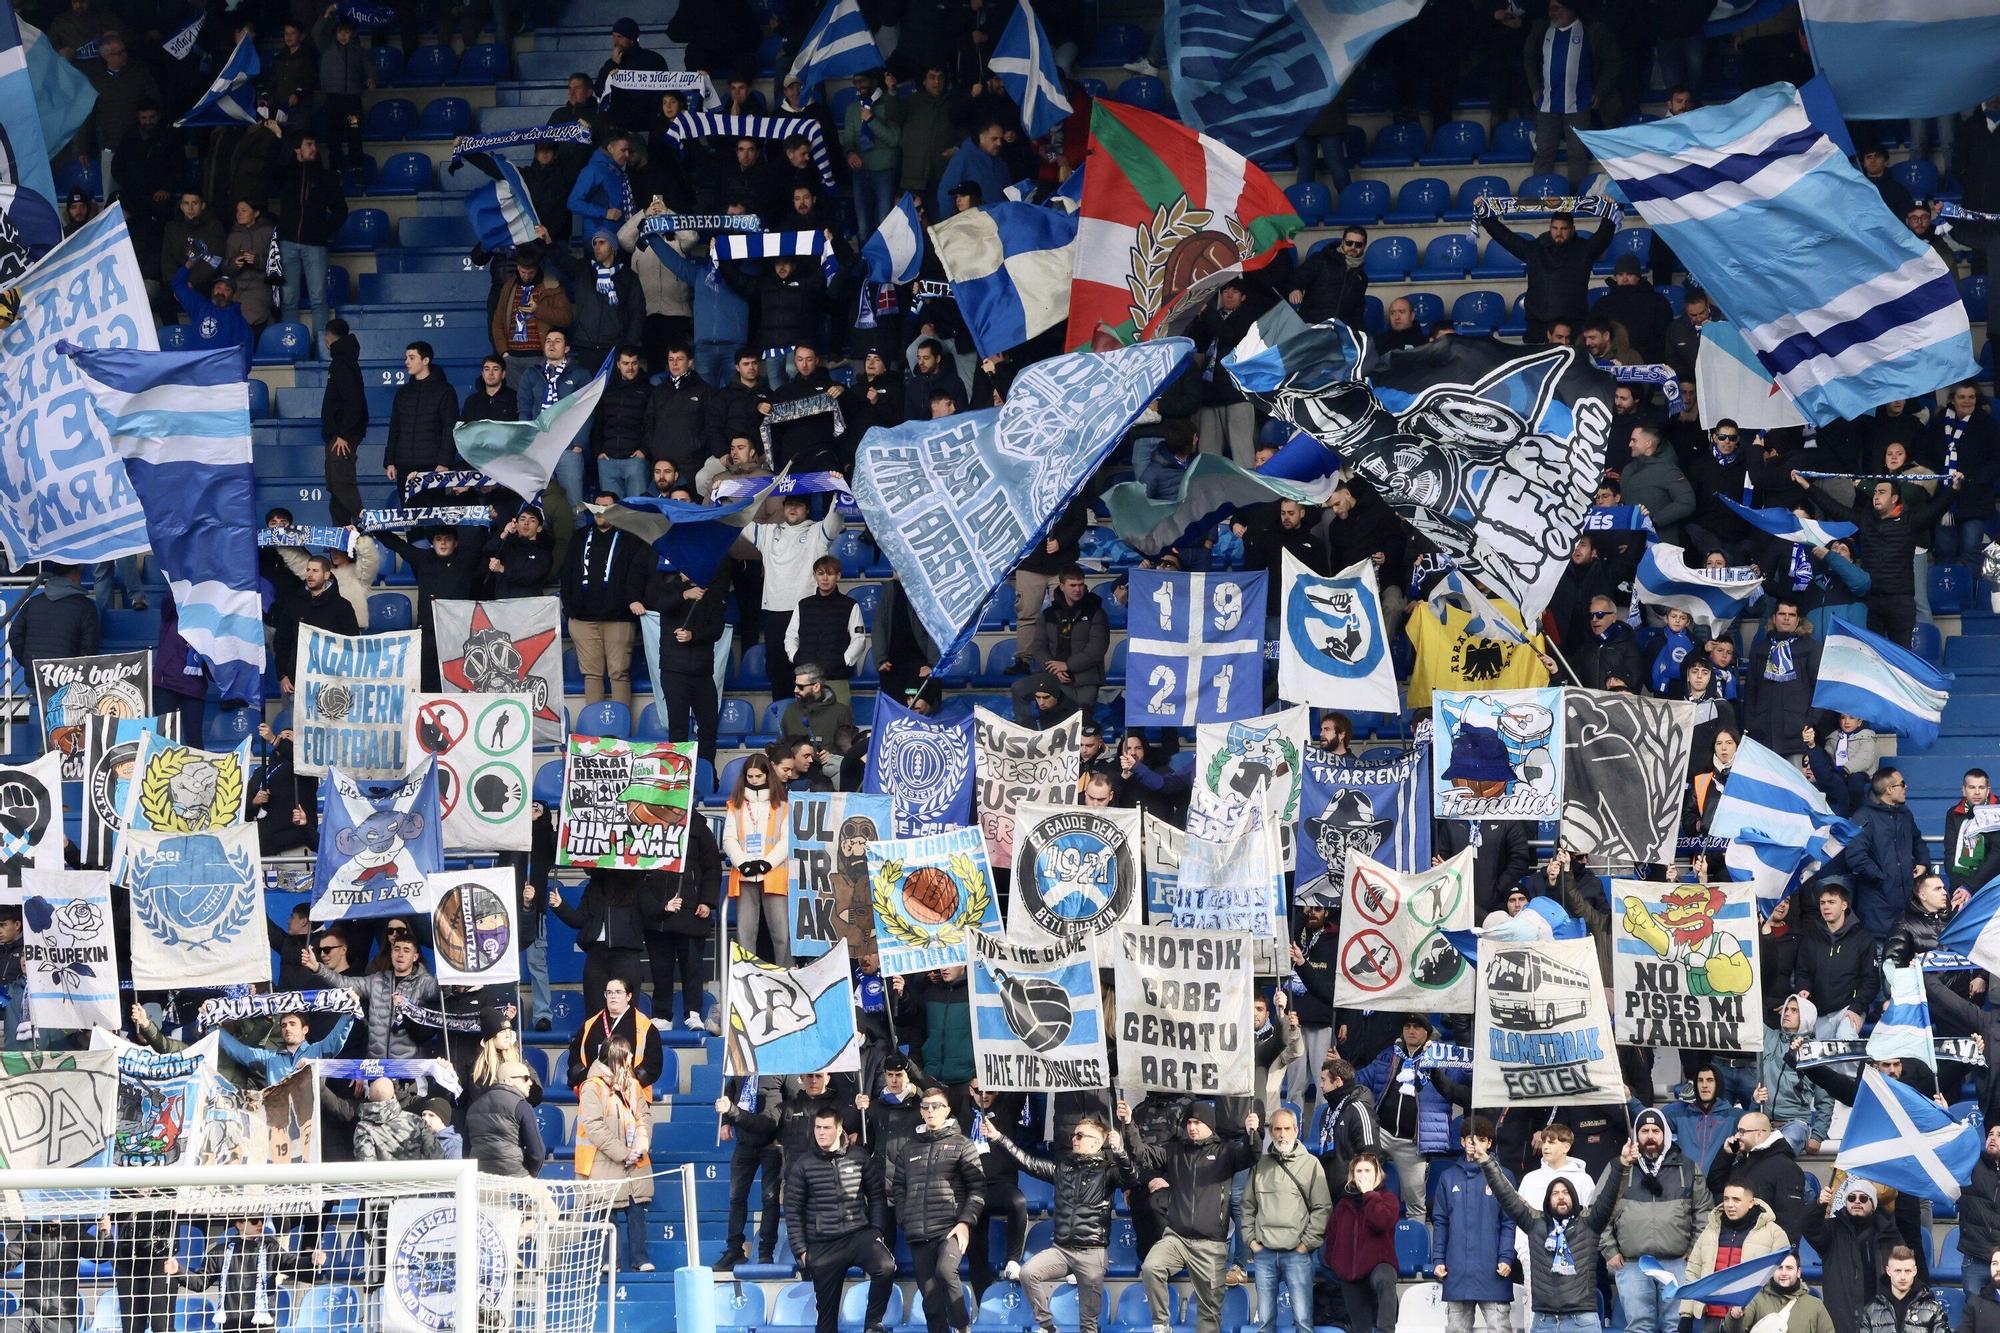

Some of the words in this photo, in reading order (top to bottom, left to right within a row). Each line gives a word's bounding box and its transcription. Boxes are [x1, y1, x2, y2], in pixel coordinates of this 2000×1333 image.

[672, 215, 721, 230] ERREKO
[423, 313, 445, 328] 23
[382, 371, 405, 385] 22
[299, 488, 322, 502] 20
[405, 471, 484, 493] DEPORTIVO
[306, 631, 411, 678] AGAINST
[40, 662, 84, 688] Hiri
[303, 726, 404, 770] FOOTBALL
[975, 716, 1080, 760] EUSKAL
[573, 756, 629, 769] EUSKAL
[975, 746, 1080, 784] PRESOAK
[1305, 746, 1347, 768] ZUEN
[574, 767, 630, 780] HERRIA
[1311, 763, 1411, 786] TXARRENA
[1437, 785, 1560, 816] Fanatics
[793, 800, 834, 842] UL
[1030, 833, 1046, 849] EZ
[1045, 815, 1087, 835] GAUDE
[567, 819, 687, 859] HINTXAK
[914, 828, 983, 859] EGUNGO
[793, 849, 832, 892] TR
[1042, 844, 1115, 884] 1921
[332, 890, 374, 905] WIN
[378, 881, 424, 902] EASY
[796, 899, 838, 942] AK
[1035, 908, 1062, 932] BETI
[49, 944, 109, 964] GUREKIN
[1011, 944, 1040, 964] THE
[1635, 961, 1679, 993] NO
[1141, 977, 1221, 1012] GABE
[1625, 991, 1701, 1021] PISES
[1711, 995, 1746, 1023] MI
[1122, 1011, 1238, 1052] GERATU
[1489, 1026, 1605, 1065] KILOMETROAK
[1630, 1018, 1742, 1050] JARDIN
[984, 1053, 1014, 1087] HATE
[1016, 1054, 1041, 1087] THE
[1040, 1057, 1104, 1089] BUSINESS
[1141, 1055, 1219, 1090] ARTE
[1503, 1064, 1594, 1098] EGITEN
[275, 1143, 288, 1156] 19
[706, 1164, 717, 1179] 6
[663, 1225, 674, 1239] 5
[616, 1286, 627, 1300] 4
